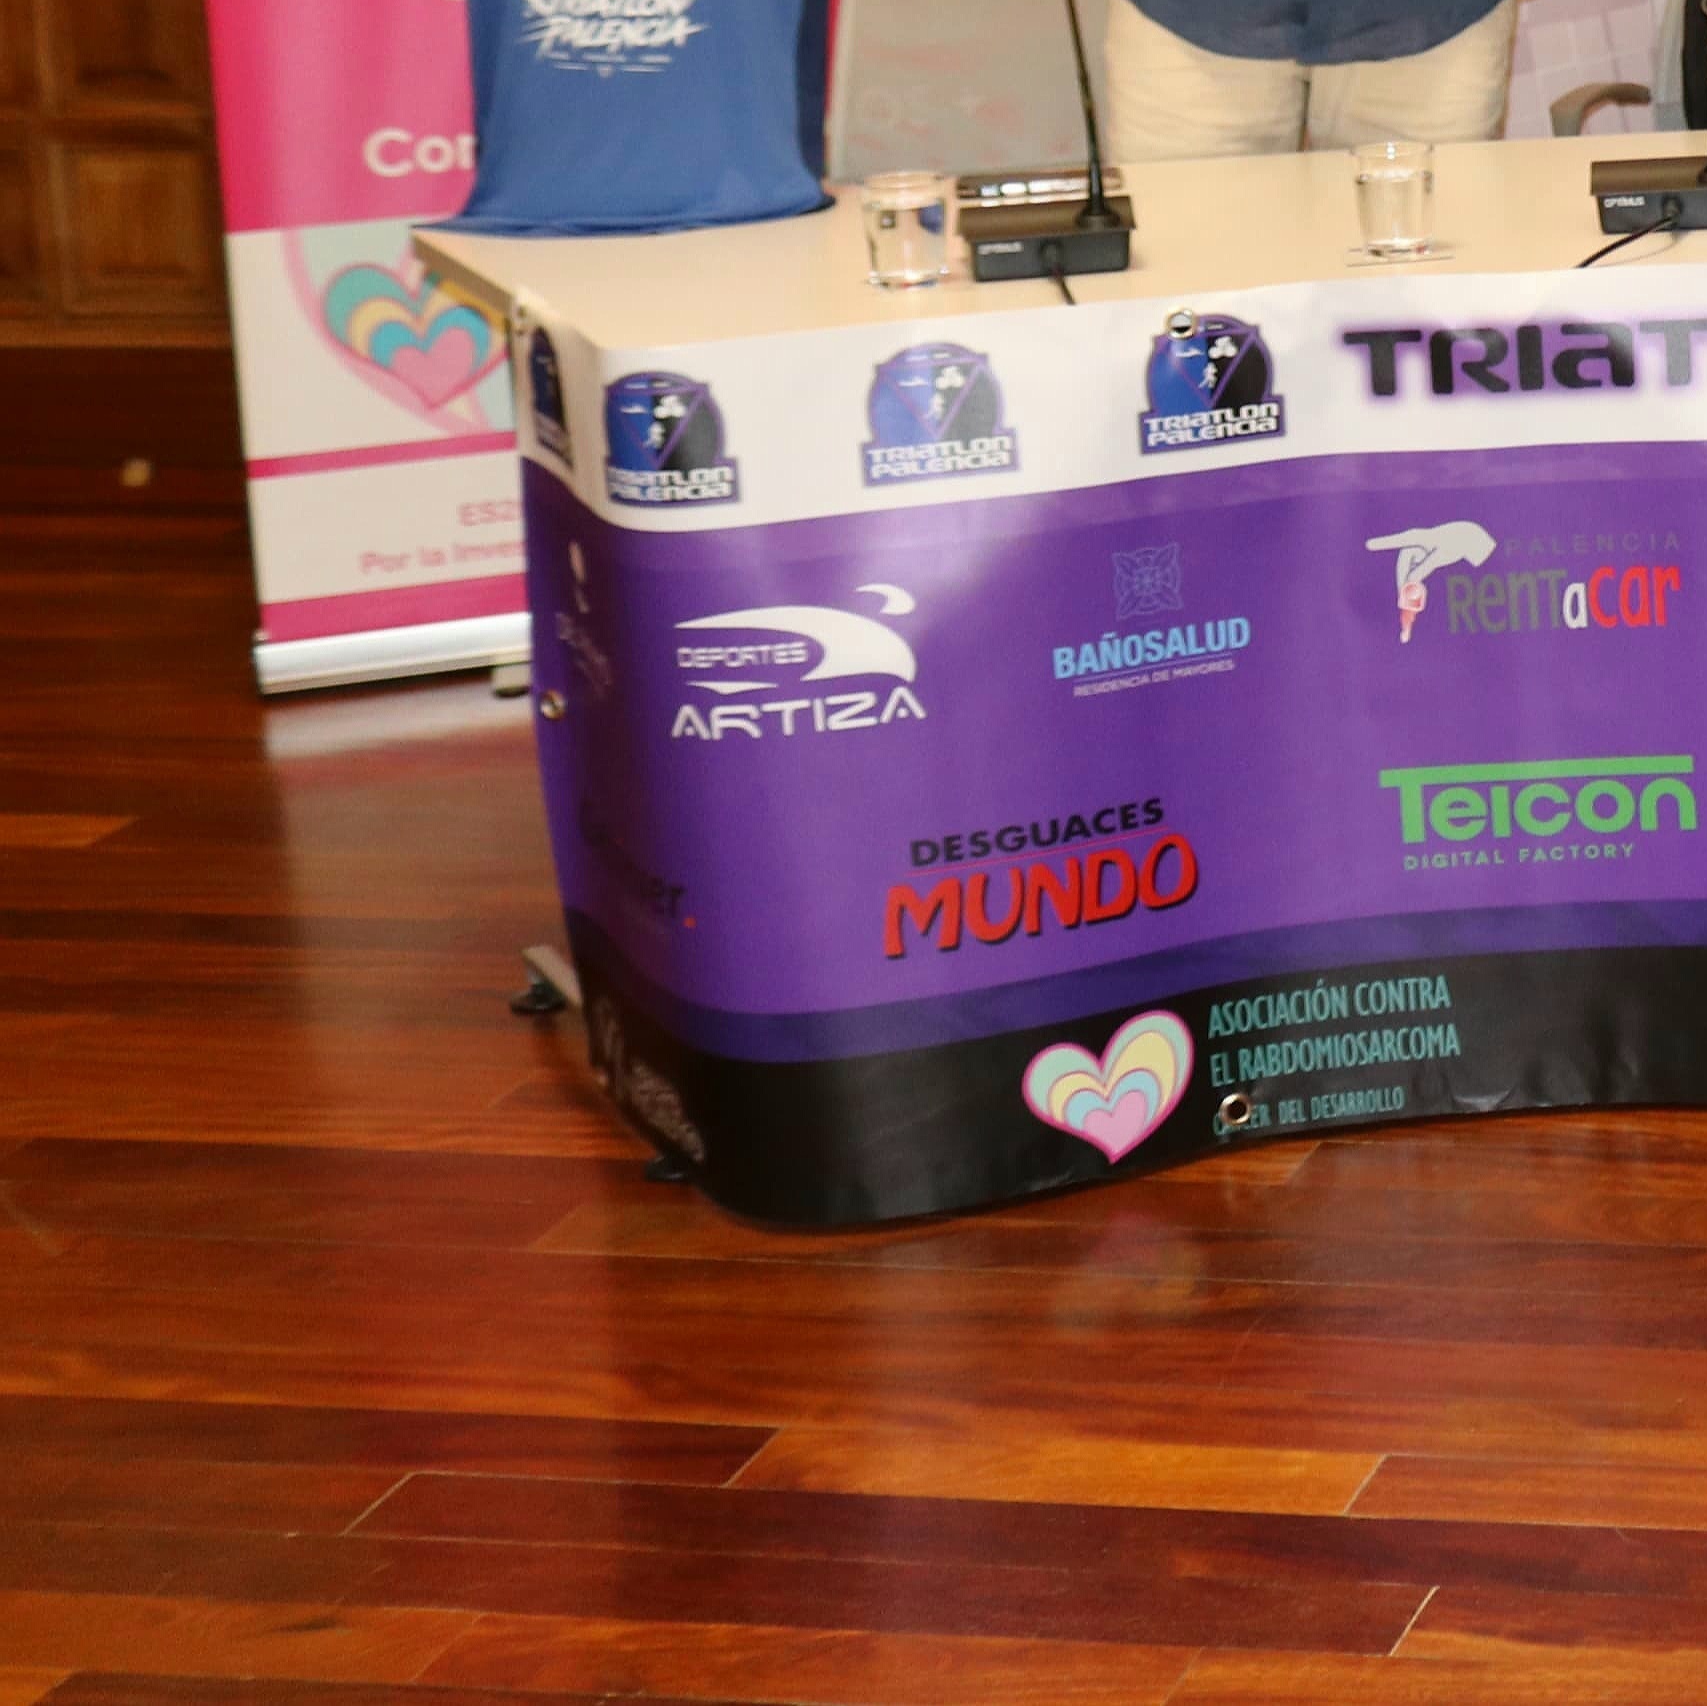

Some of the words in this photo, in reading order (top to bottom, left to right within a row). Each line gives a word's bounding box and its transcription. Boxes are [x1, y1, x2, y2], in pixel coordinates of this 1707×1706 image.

[1506, 532, 1681, 559] PALENCIA
[676, 641, 809, 669] DEPORTES
[1053, 617, 1250, 680] BAÑOSALUD
[671, 686, 927, 740] ARTIZA
[910, 798, 1164, 867] DESGUACES
[1404, 850, 1505, 872] DIGITAL
[1518, 842, 1636, 863] FACTORY
[882, 832, 1198, 959] MUNDO
[1208, 979, 1348, 1039] ASOCIACIÓN
[1354, 975, 1451, 1017] CONTRA
[1210, 1051, 1235, 1088] EL
[1238, 1023, 1461, 1081] RABDOMIOSARCOMA
[1279, 1099, 1307, 1125] DEL
[1311, 1086, 1406, 1121] DESARROLLO
